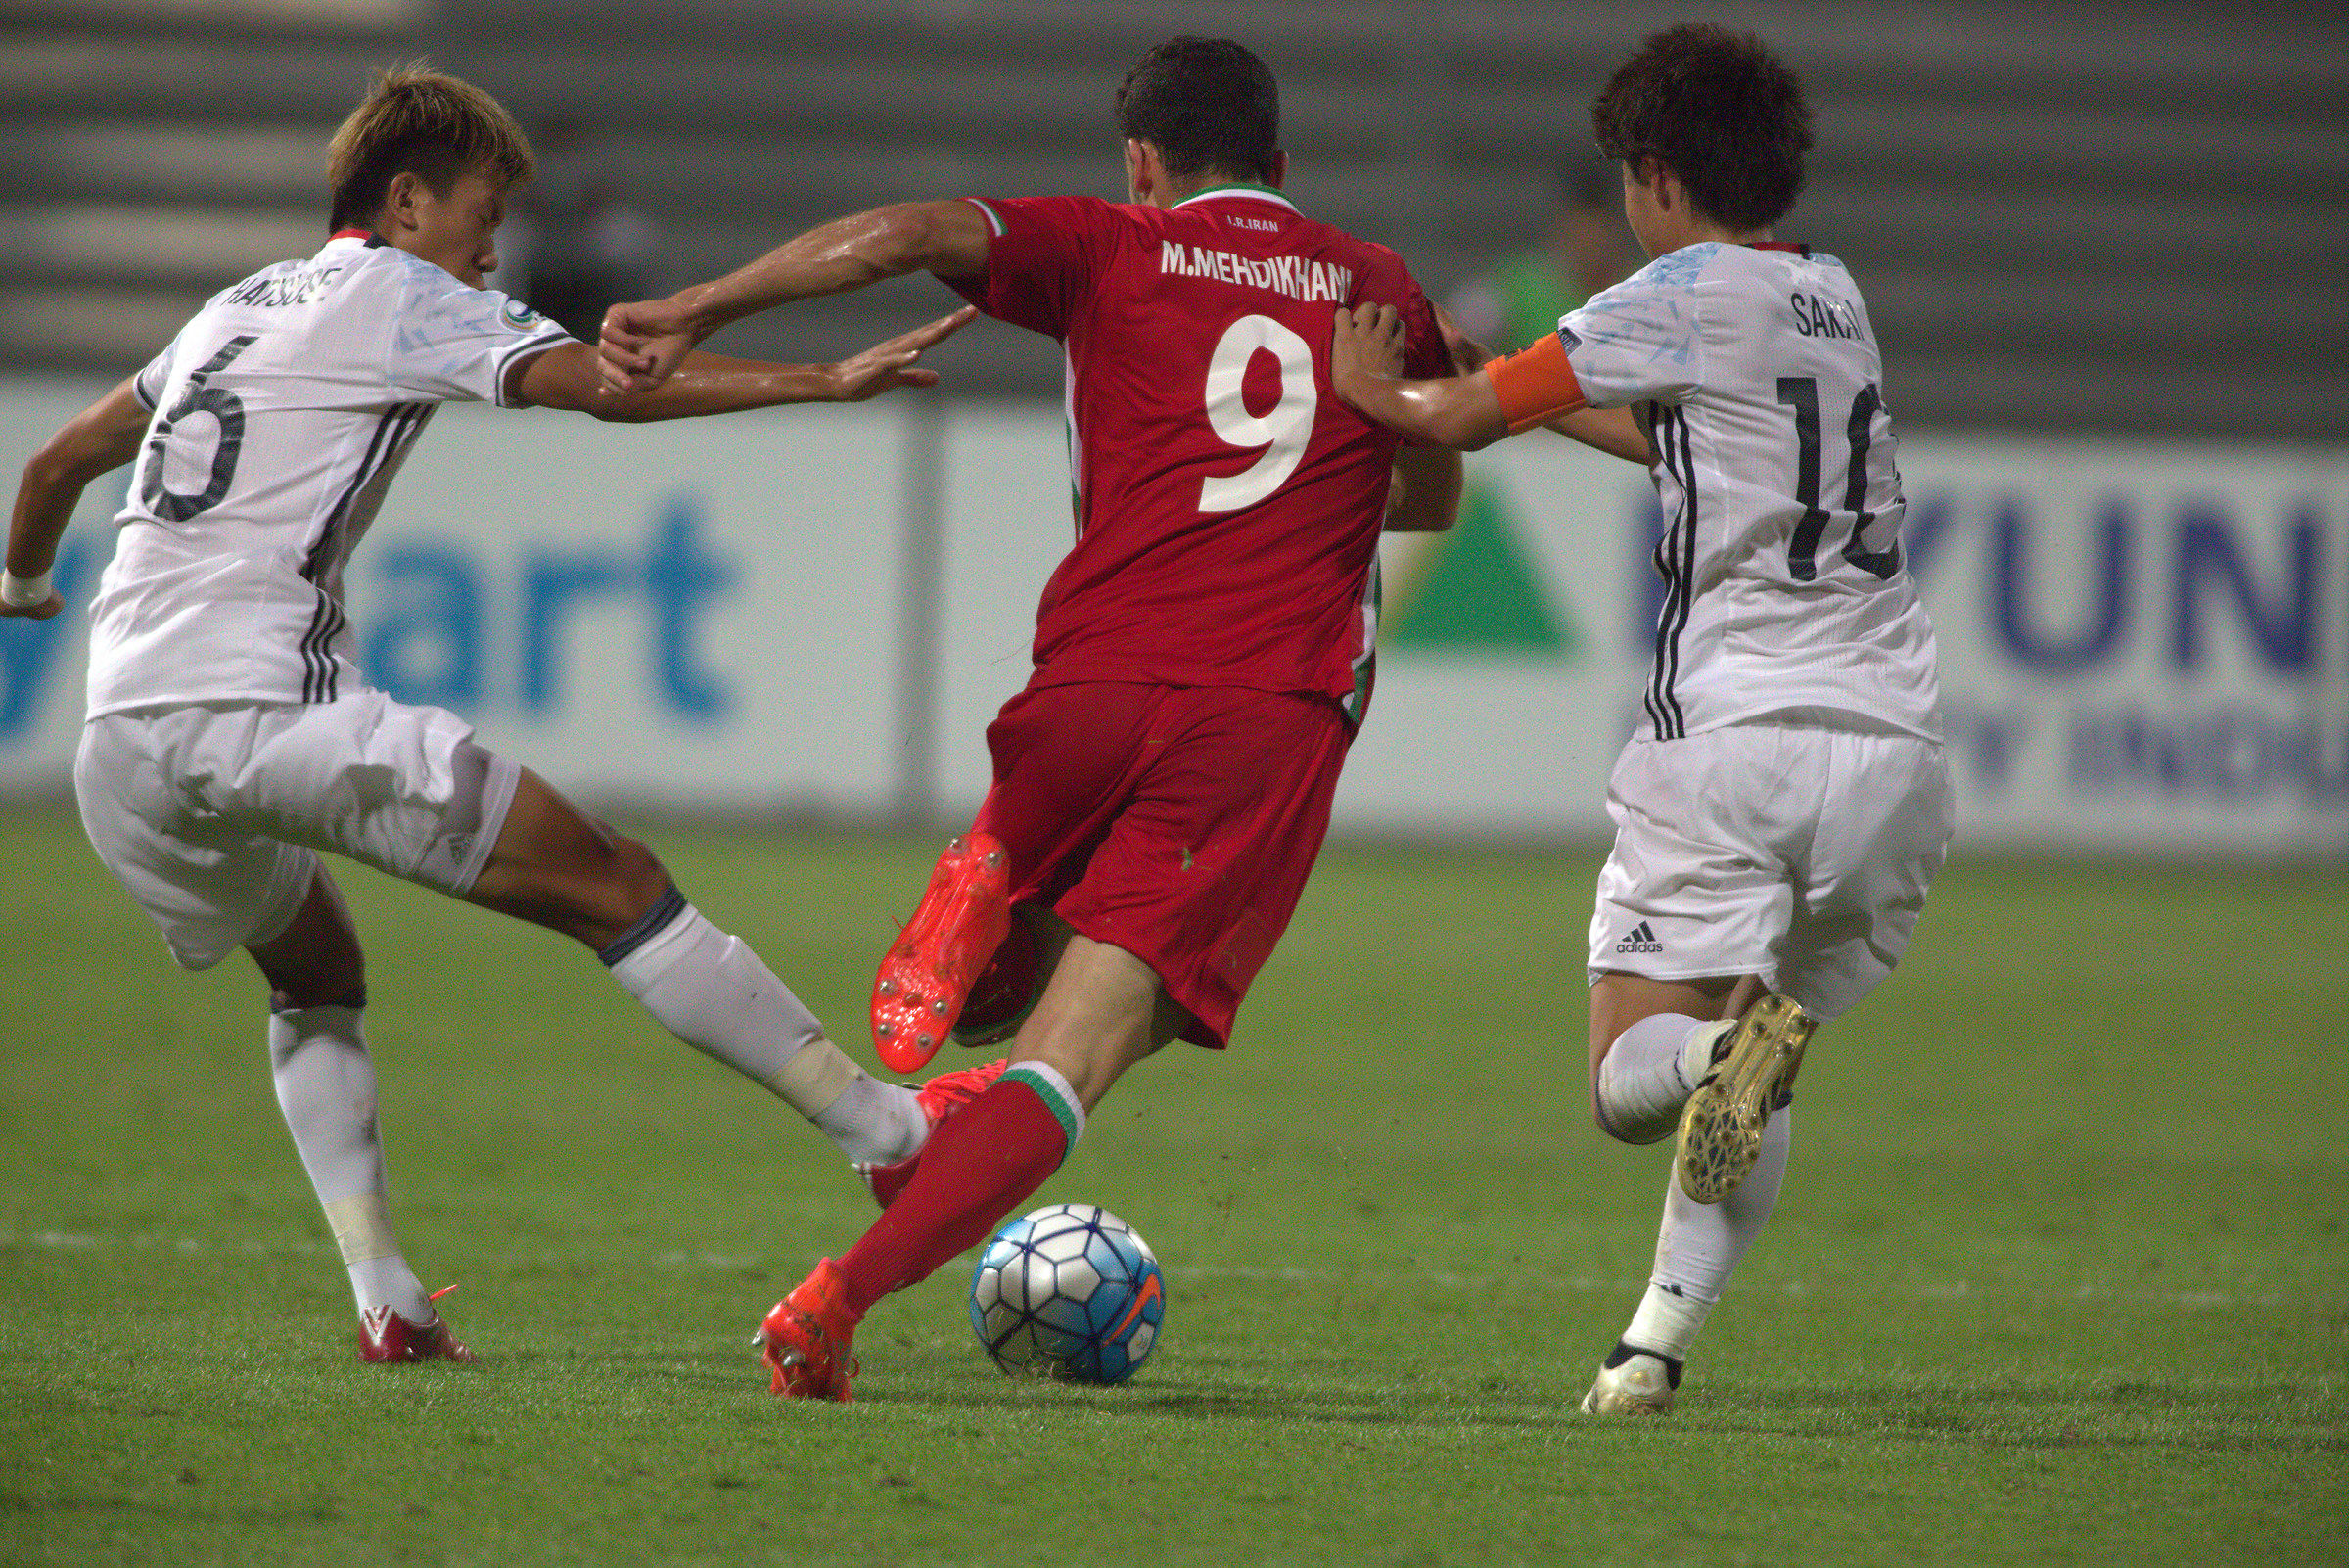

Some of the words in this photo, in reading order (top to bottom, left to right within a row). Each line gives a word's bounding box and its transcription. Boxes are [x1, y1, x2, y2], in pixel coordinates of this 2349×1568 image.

[1226, 214, 1279, 233] I.R.IRAN
[141, 335, 261, 523] 6
[1198, 314, 1318, 513] 9
[1776, 377, 1907, 582] 10
[1616, 941, 1664, 954] adidas
